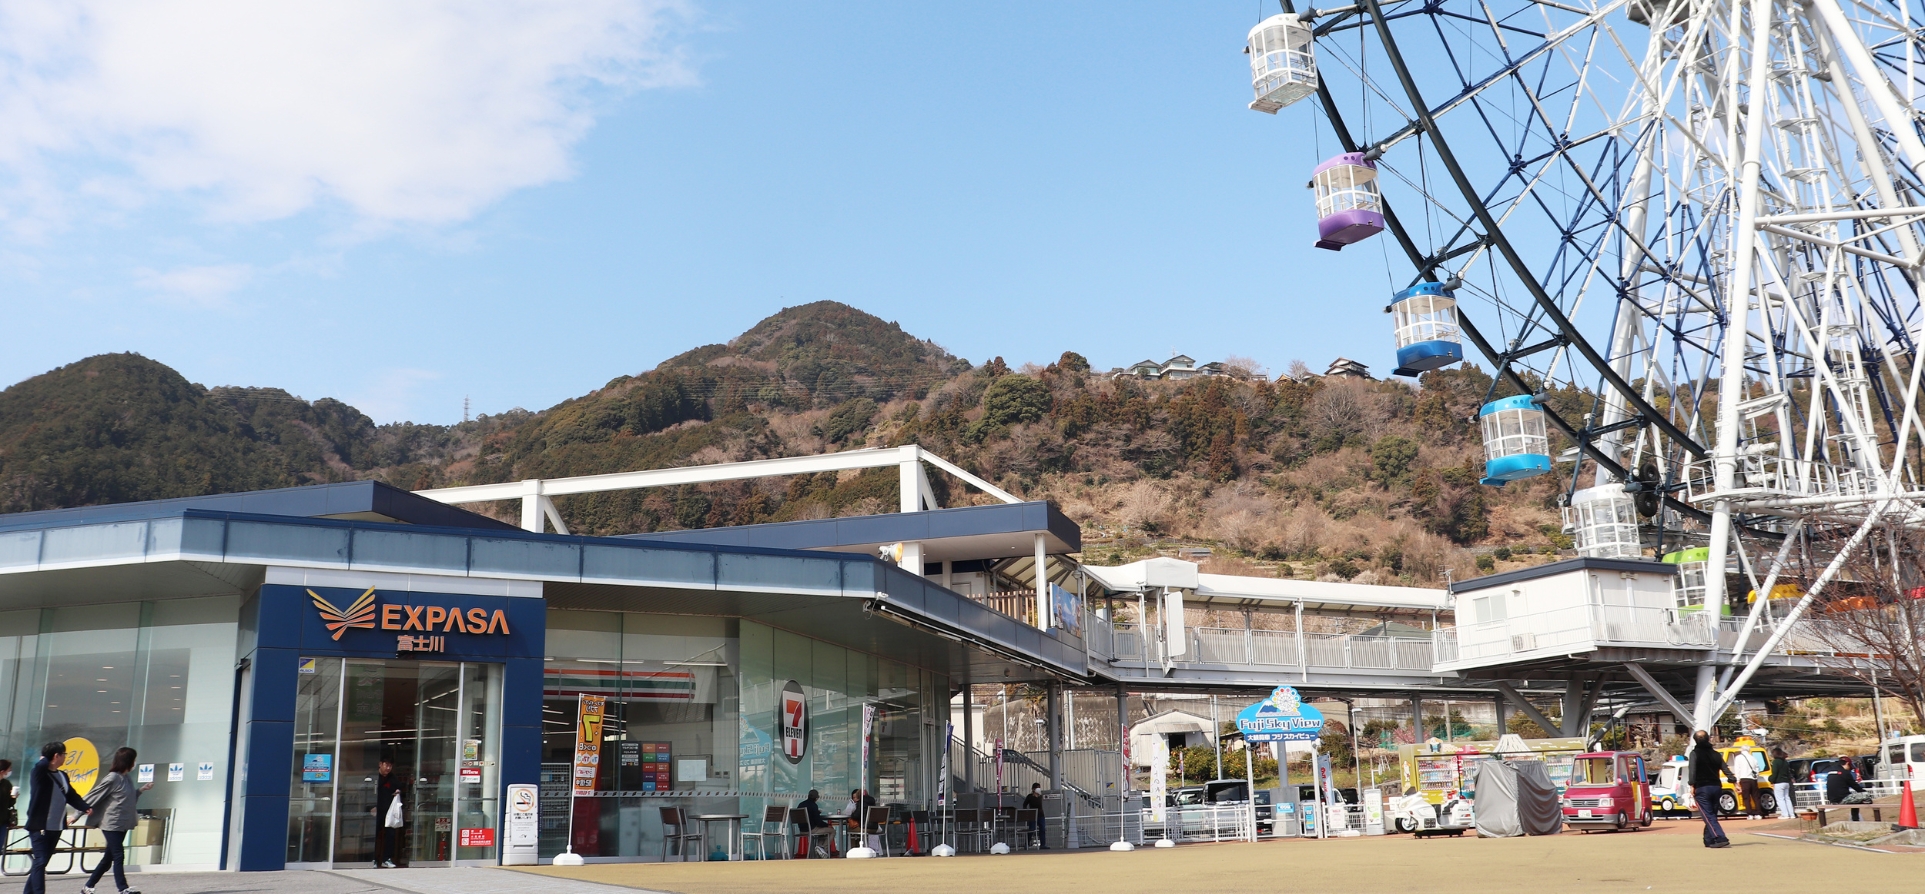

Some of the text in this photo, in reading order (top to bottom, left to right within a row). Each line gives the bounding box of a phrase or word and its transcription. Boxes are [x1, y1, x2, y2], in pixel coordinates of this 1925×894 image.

[381, 604, 510, 635] EXPASA
[397, 635, 445, 652] 富士川
[786, 699, 803, 758] 7
[1240, 718, 1320, 731] Fuji Sky View
